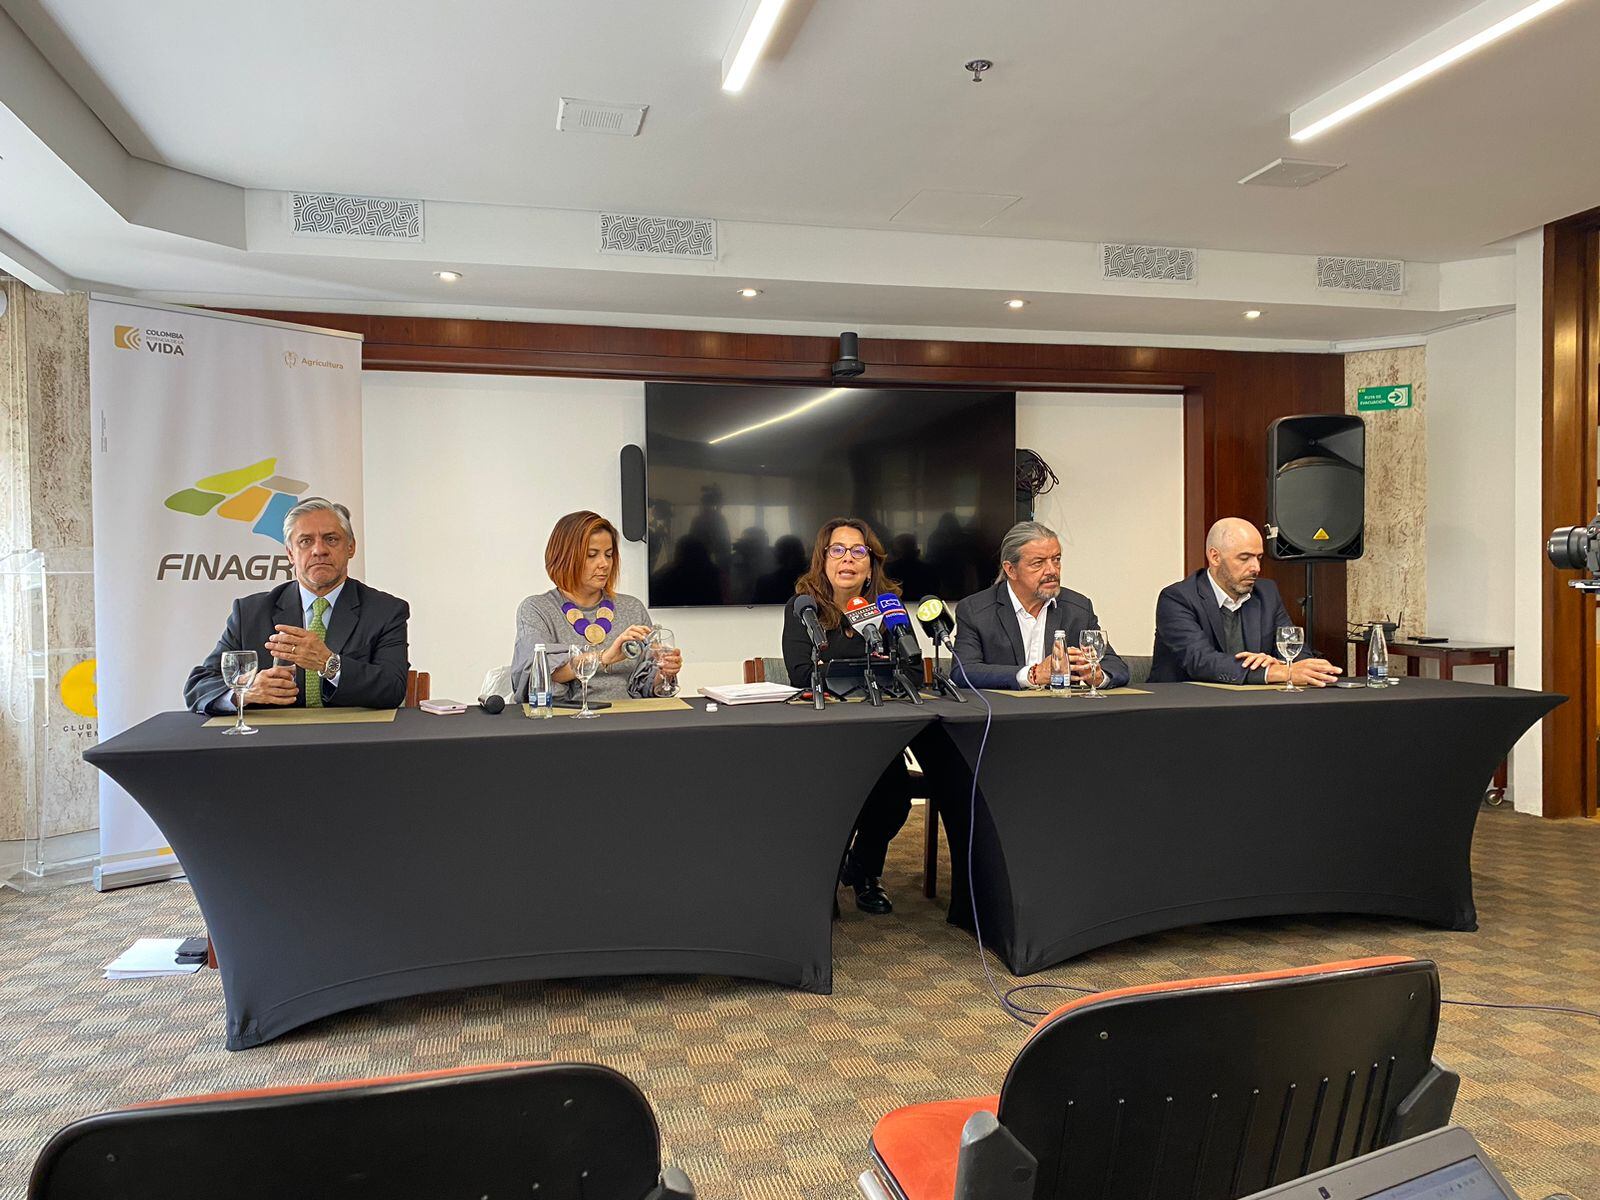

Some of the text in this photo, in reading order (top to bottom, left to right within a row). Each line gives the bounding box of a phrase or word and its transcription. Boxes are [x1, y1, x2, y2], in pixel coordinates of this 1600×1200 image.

[145, 329, 185, 340] COLOMBIA
[146, 341, 185, 356] VIDA
[301, 357, 344, 370] Agricultura
[156, 553, 297, 581] FINAGR
[921, 600, 942, 620] 30
[63, 723, 92, 732] CLUB
